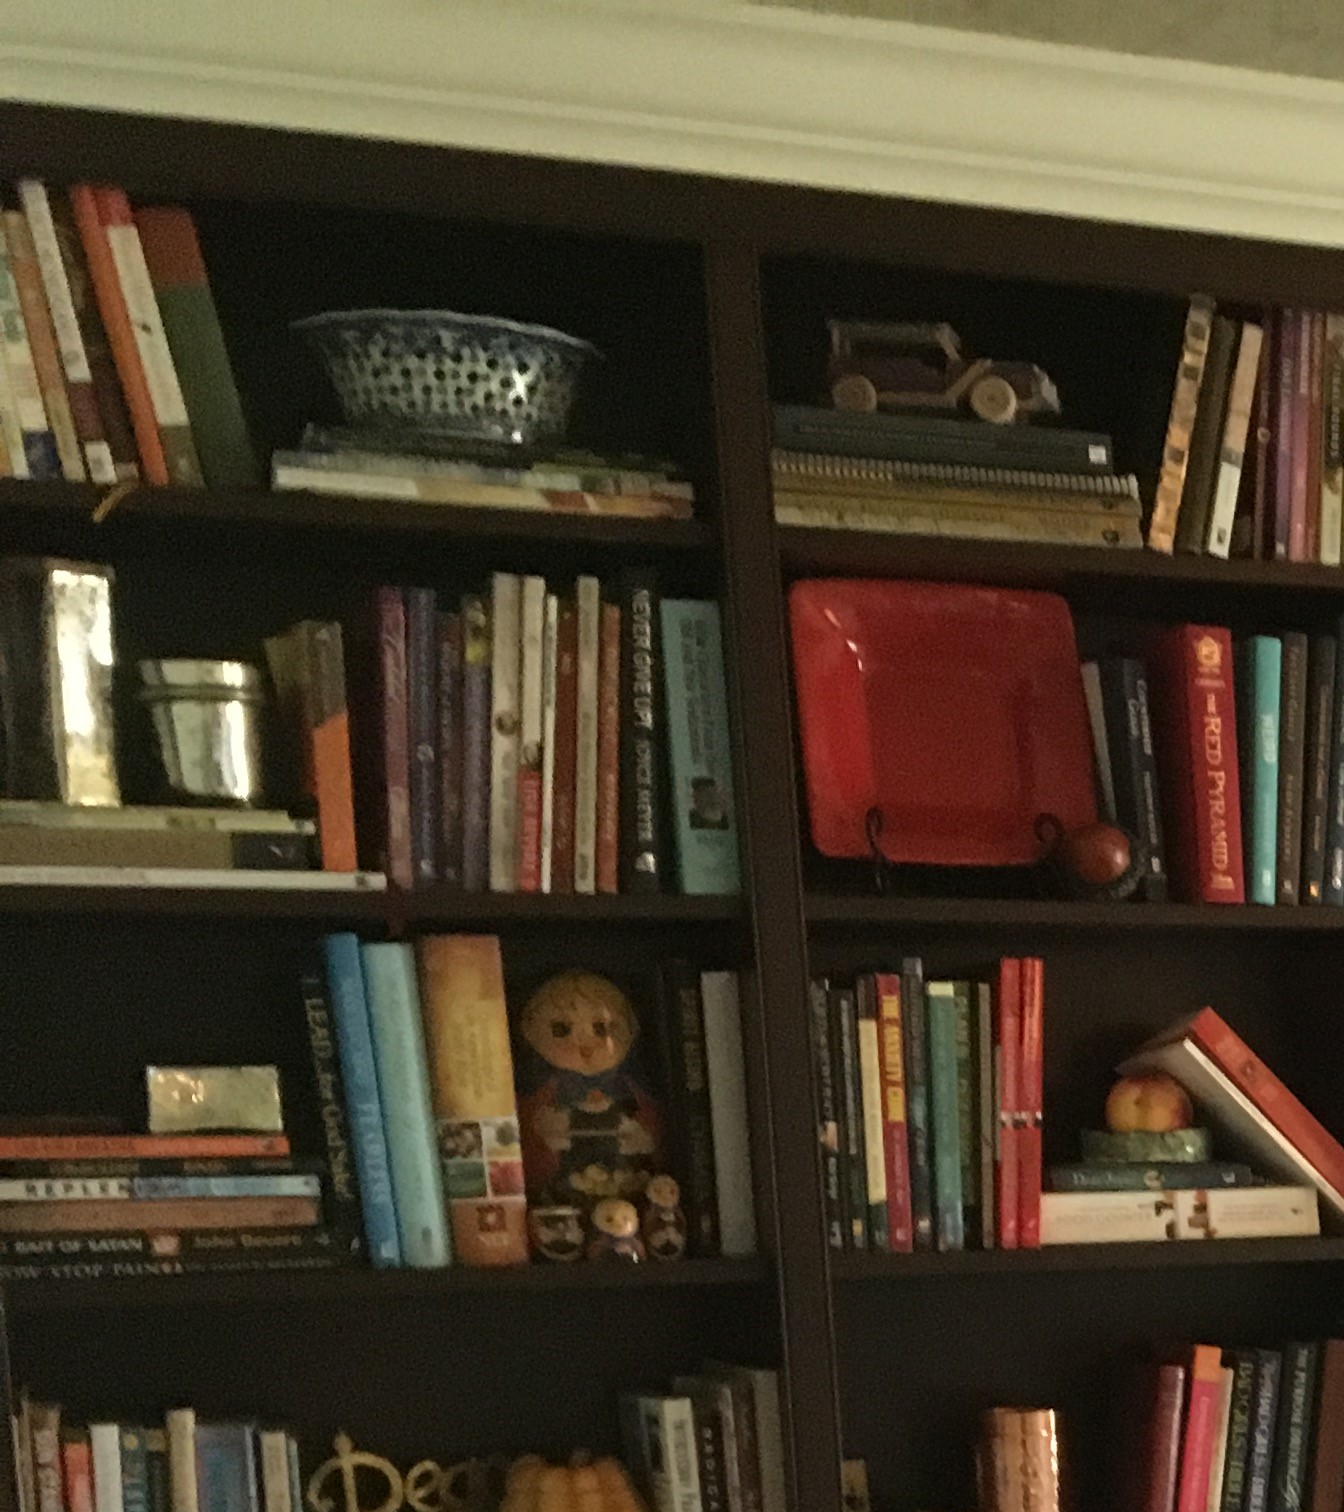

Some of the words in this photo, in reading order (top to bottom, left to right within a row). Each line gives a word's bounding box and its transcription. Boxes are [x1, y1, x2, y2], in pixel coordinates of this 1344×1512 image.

[632, 589, 653, 649] NEVER
[634, 652, 653, 694] GIVE
[1202, 716, 1222, 766] RED
[1207, 770, 1230, 871] PYRAMID
[14, 1239, 53, 1253] BAIT
[58, 1239, 83, 1252] OF
[87, 1238, 144, 1253] SATAN
[1227, 1460, 1244, 1509] BIBLE
